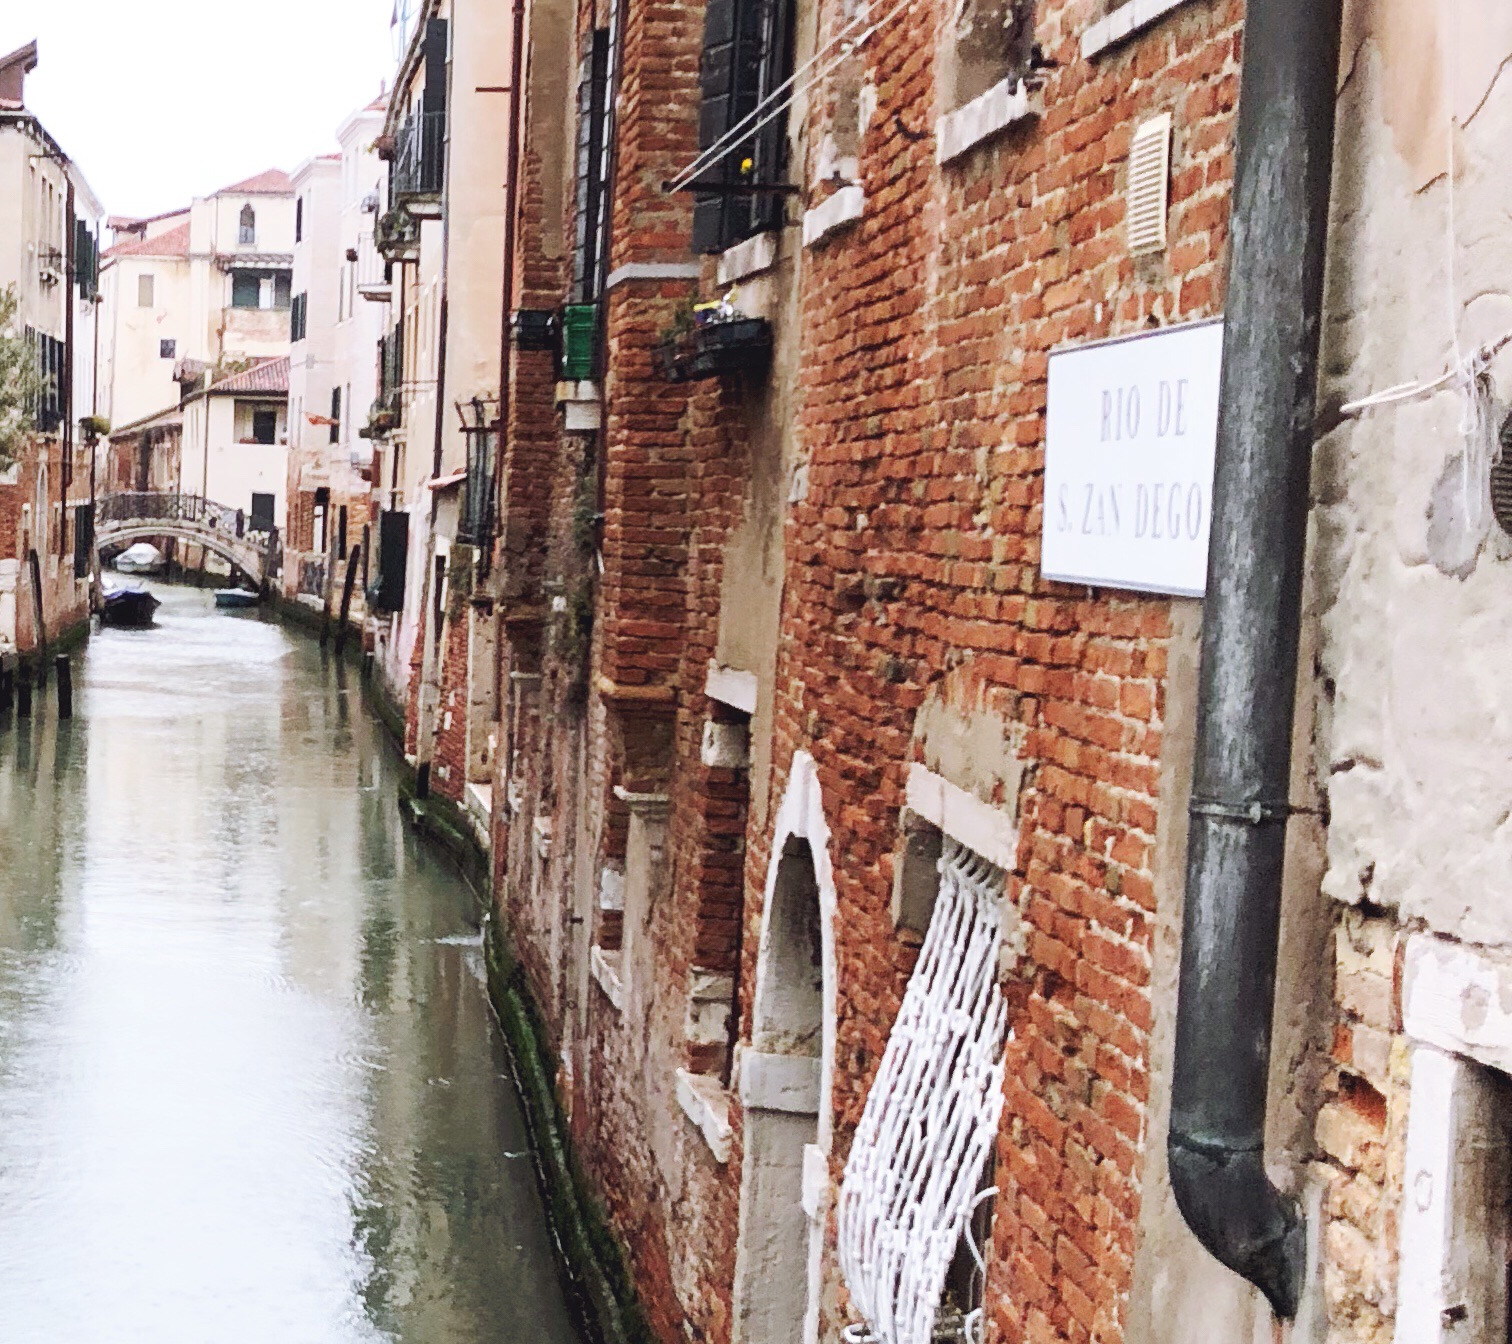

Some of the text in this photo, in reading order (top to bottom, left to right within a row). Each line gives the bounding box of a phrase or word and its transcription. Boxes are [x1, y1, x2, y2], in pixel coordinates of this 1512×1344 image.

[1100, 378, 1188, 441] RIO DE
[1058, 483, 1073, 532] S.
[1082, 483, 1122, 535] ZAN
